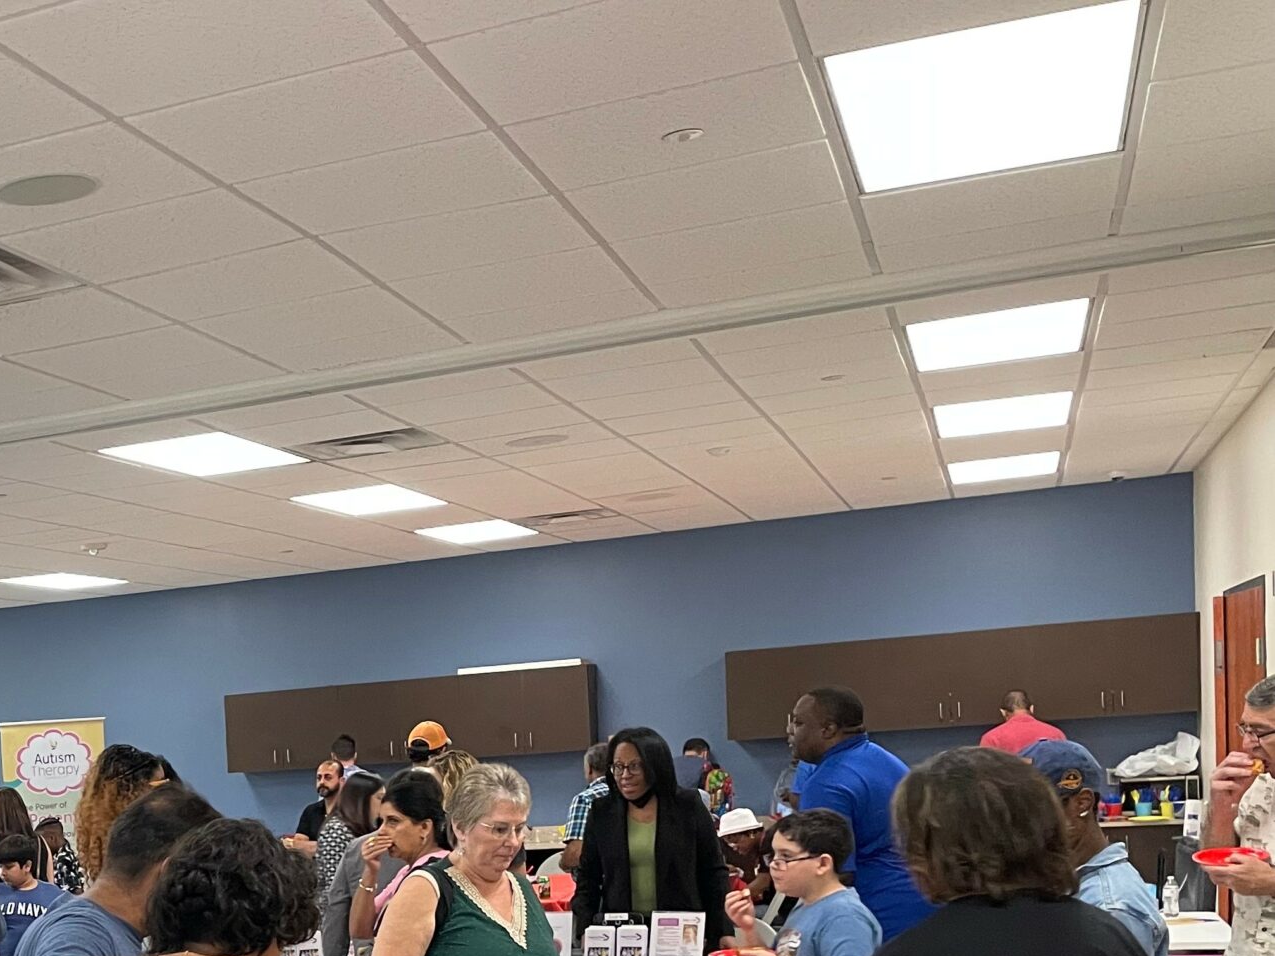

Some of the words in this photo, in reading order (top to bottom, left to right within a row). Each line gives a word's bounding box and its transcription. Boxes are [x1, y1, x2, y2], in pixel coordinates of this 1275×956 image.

[34, 753, 76, 765] Autism
[32, 764, 80, 777] Therapy
[35, 802, 58, 810] Power
[59, 801, 67, 809] of
[17, 901, 48, 917] NAVY
